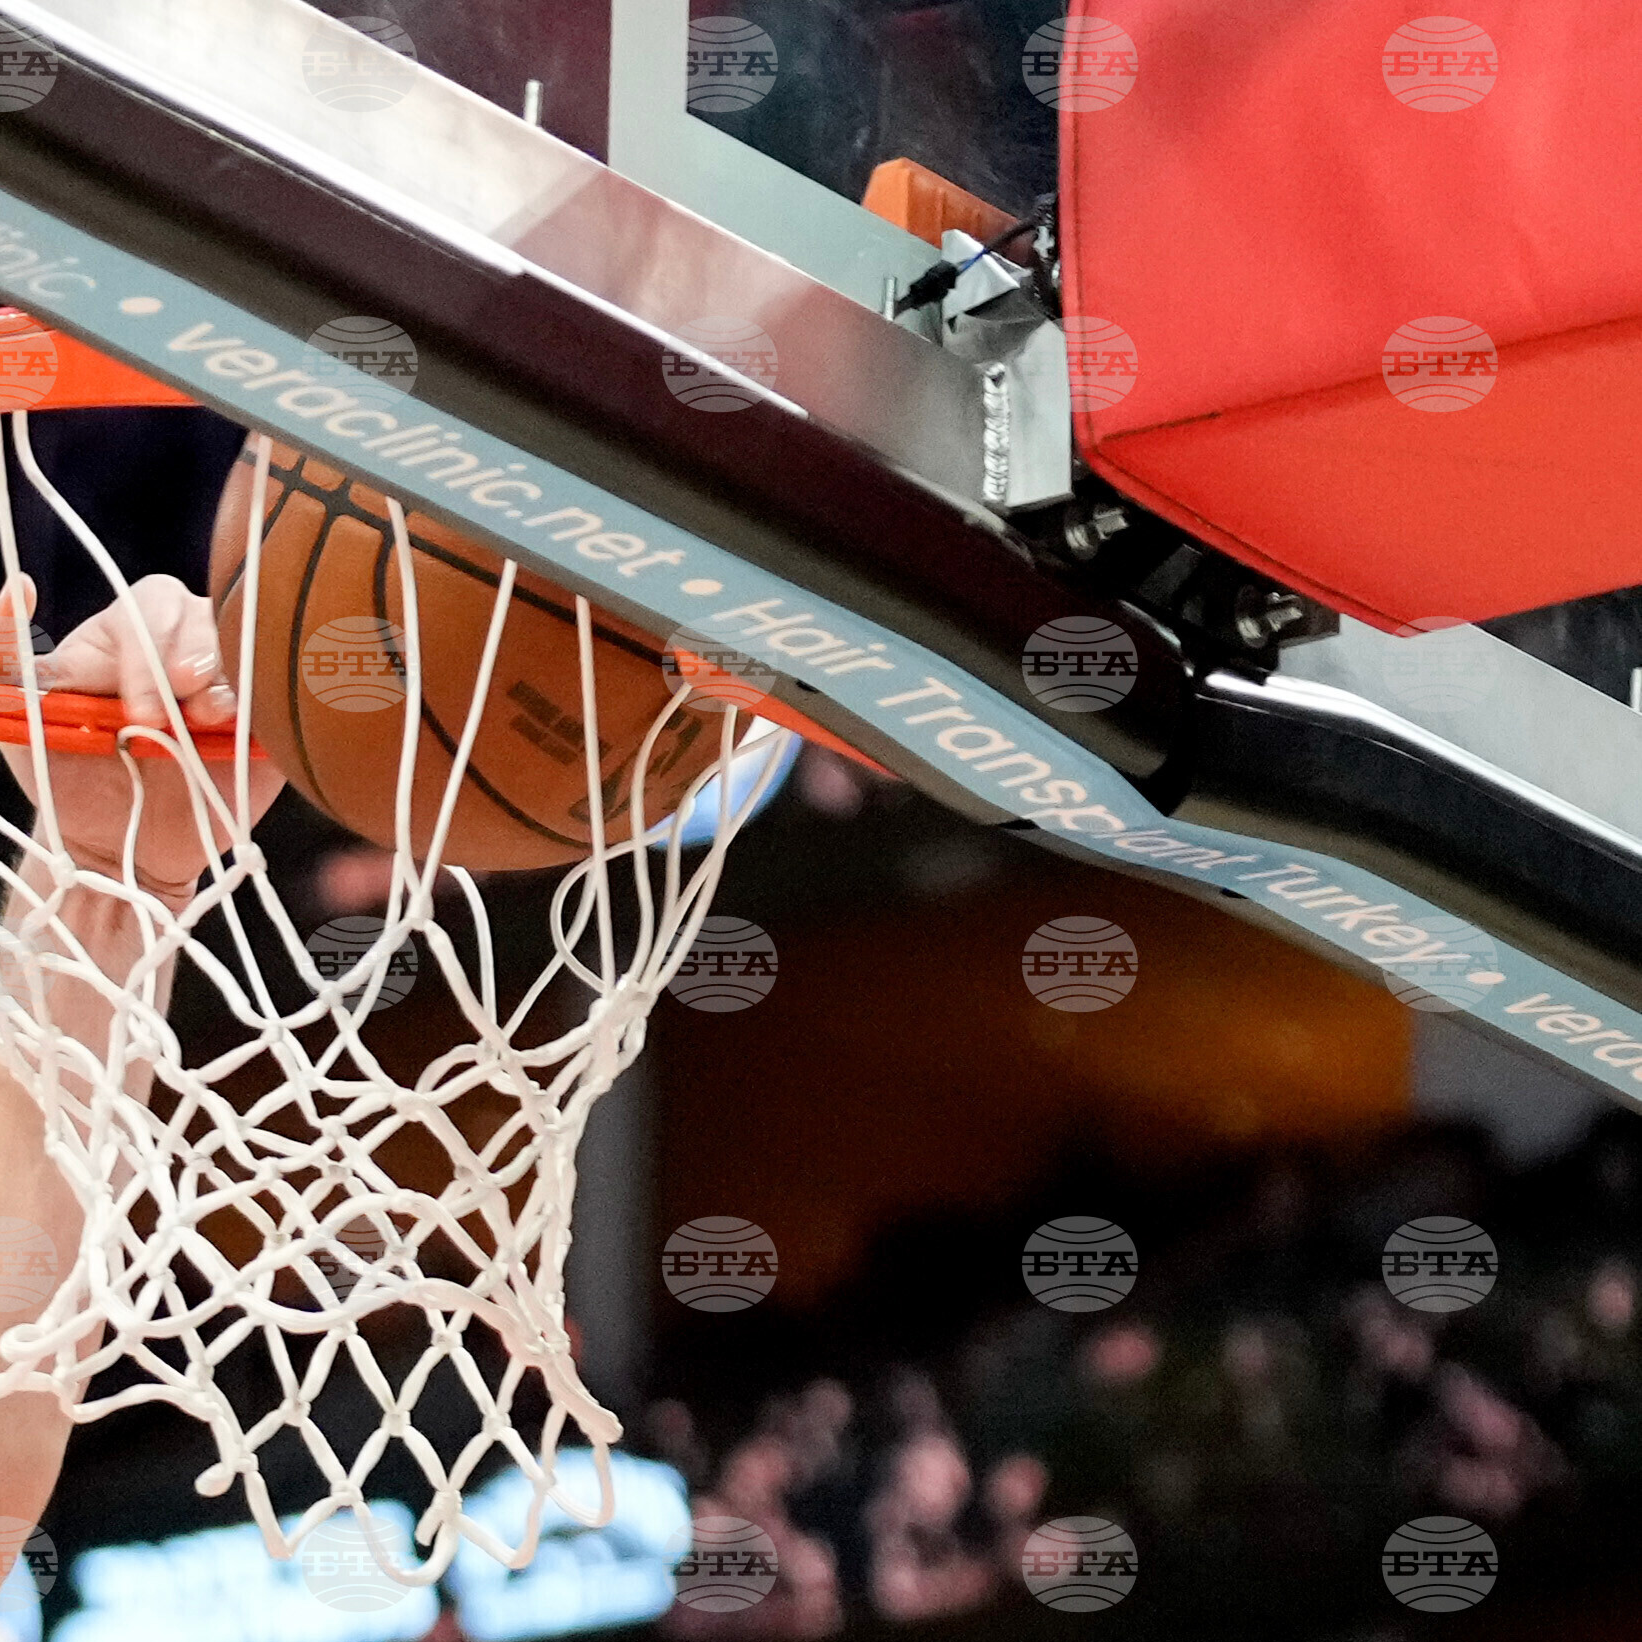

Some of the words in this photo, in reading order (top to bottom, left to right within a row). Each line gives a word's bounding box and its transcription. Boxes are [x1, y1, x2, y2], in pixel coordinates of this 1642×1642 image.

[167, 322, 686, 577] veraclinic.net
[711, 598, 896, 675] Hair
[876, 677, 1264, 870] Transplant
[1237, 863, 1471, 966] Turkey
[1503, 992, 1642, 1083] vera
